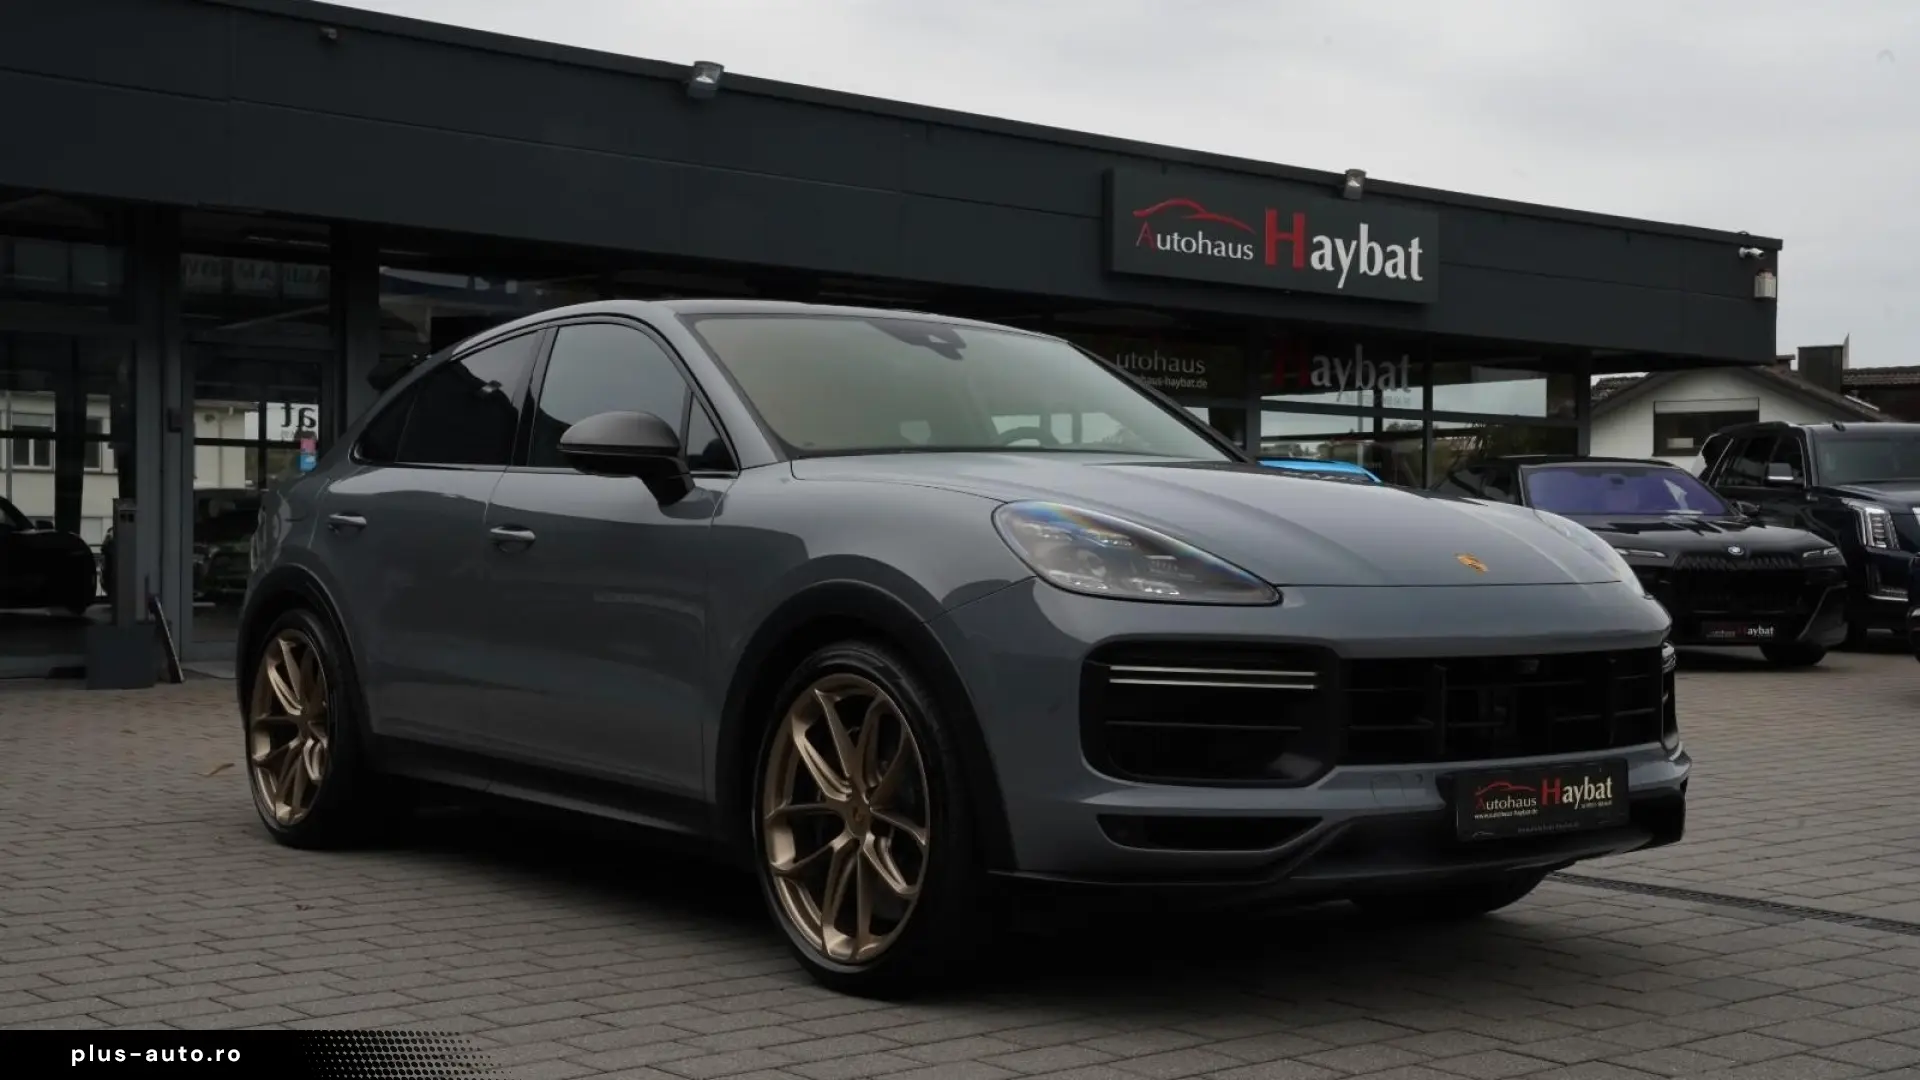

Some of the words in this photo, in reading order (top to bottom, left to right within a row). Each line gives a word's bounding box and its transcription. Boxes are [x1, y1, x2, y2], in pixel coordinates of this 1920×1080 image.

[1135, 221, 1254, 261] Autohaus
[1265, 207, 1424, 289] Haybat
[1115, 347, 1206, 375] utohaus
[1271, 336, 1412, 402] Haybat
[1475, 794, 1537, 811] Autohaus
[1541, 775, 1613, 810] Haybat
